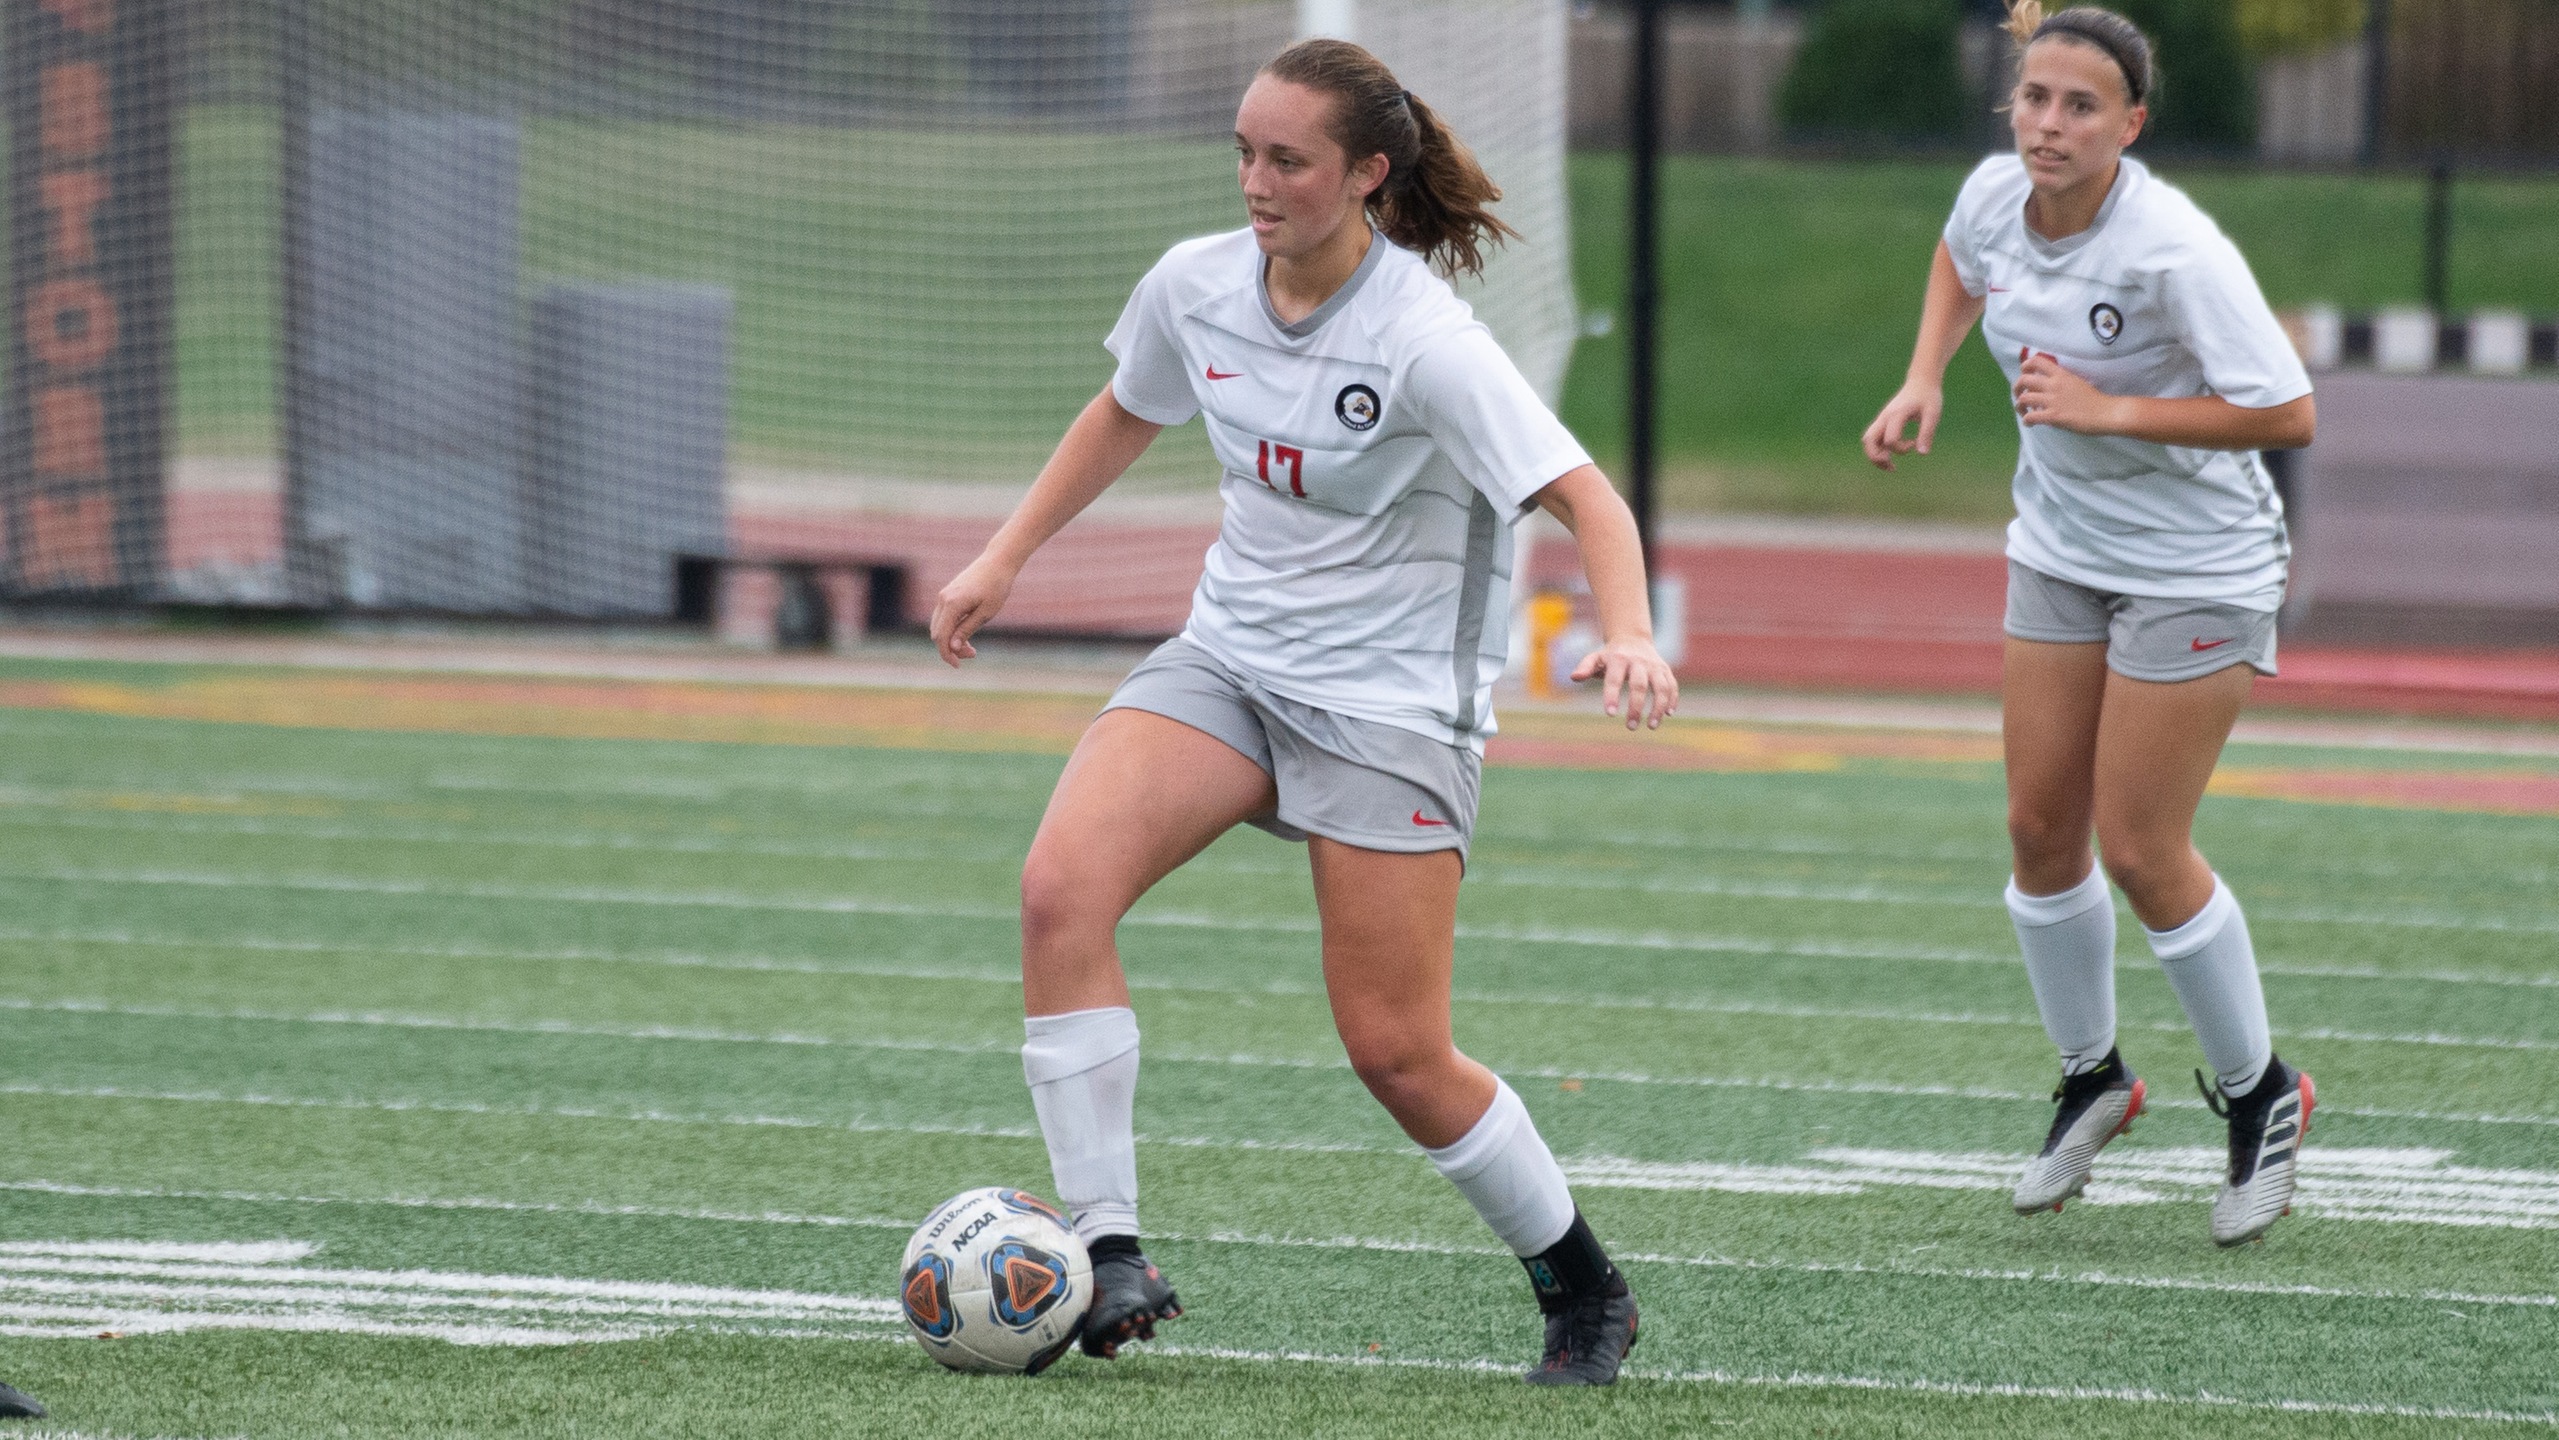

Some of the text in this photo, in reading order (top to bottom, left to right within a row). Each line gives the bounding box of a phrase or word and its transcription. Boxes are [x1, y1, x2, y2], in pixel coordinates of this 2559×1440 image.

[1256, 439, 1308, 499] 17
[928, 1197, 983, 1238] Wilson
[951, 1211, 998, 1253] NCAA
